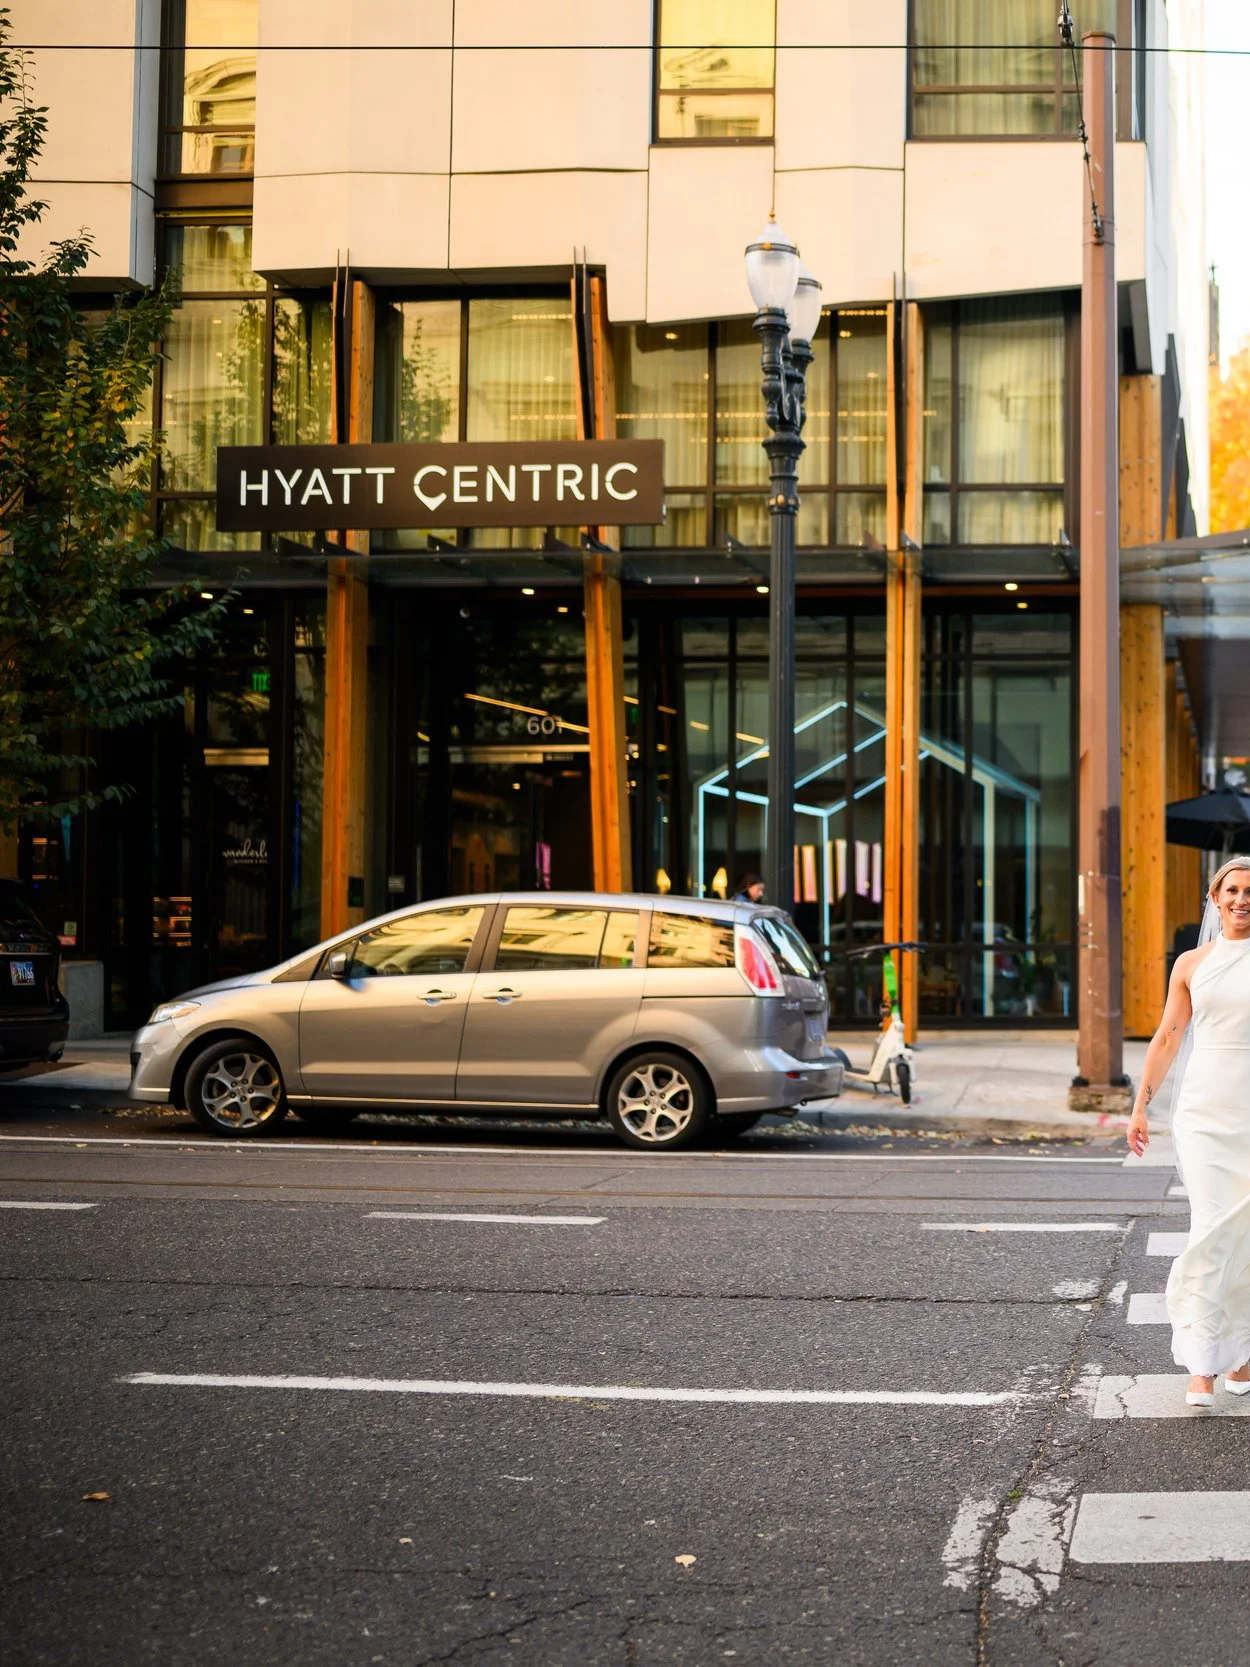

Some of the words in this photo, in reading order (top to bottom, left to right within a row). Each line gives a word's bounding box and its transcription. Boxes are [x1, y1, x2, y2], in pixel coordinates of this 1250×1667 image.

[239, 467, 396, 506] HYATT
[413, 462, 639, 511] CENTRIC
[527, 716, 563, 735] 601
